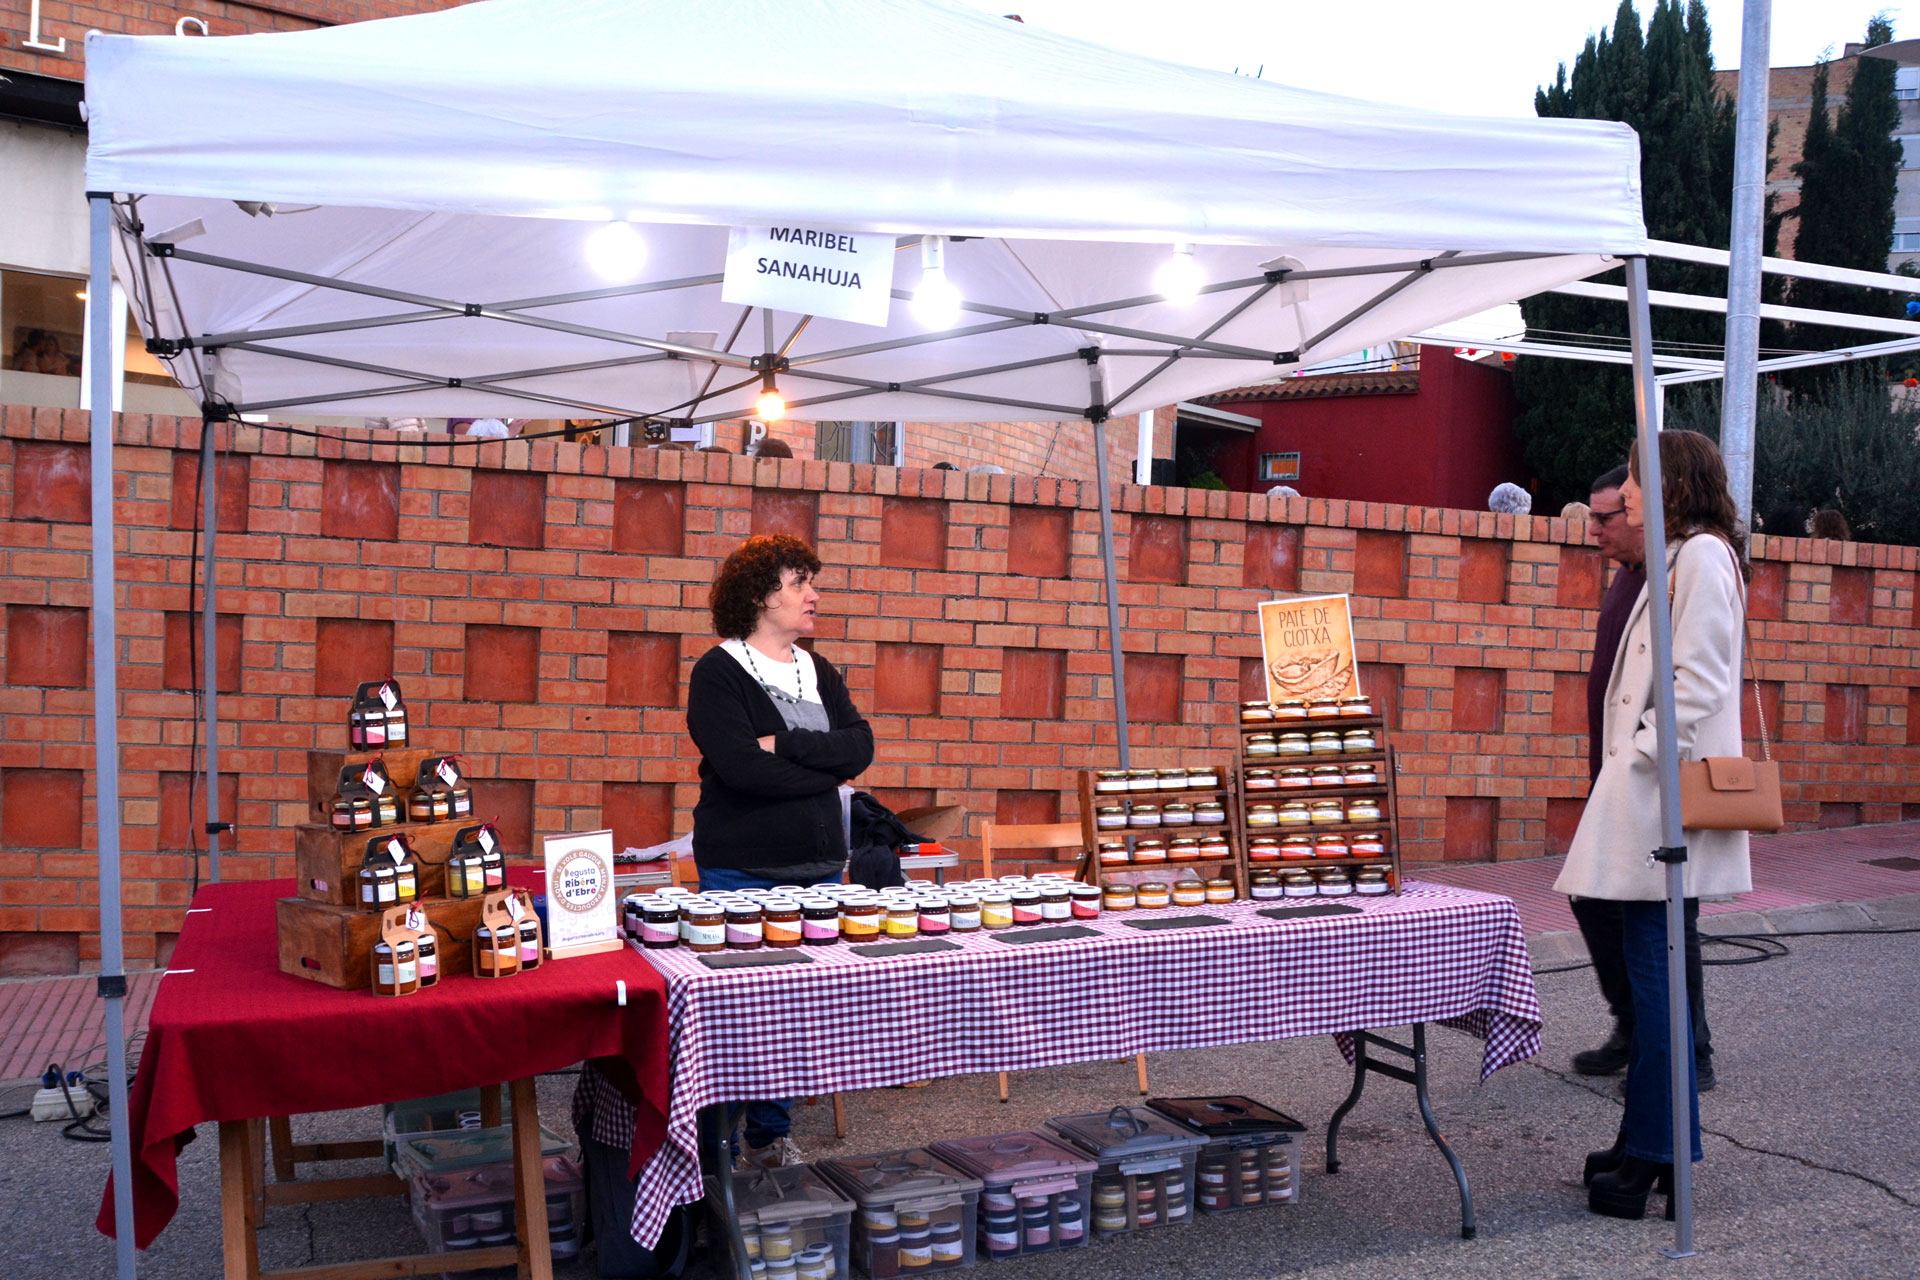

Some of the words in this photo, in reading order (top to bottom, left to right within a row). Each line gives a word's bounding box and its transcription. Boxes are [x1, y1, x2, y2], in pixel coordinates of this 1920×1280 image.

[770, 226, 858, 254] MARIBEL
[756, 257, 862, 290] SANAHUJA
[1278, 606, 1308, 628] PATÉ
[1313, 606, 1332, 626] DE
[1283, 626, 1332, 648] CLOTXA
[561, 852, 577, 866] VOLS
[565, 877, 596, 888] Ribera
[599, 868, 607, 893] MENJA
[565, 886, 597, 898] d'Ebre
[566, 893, 602, 911] PRODUCTES
